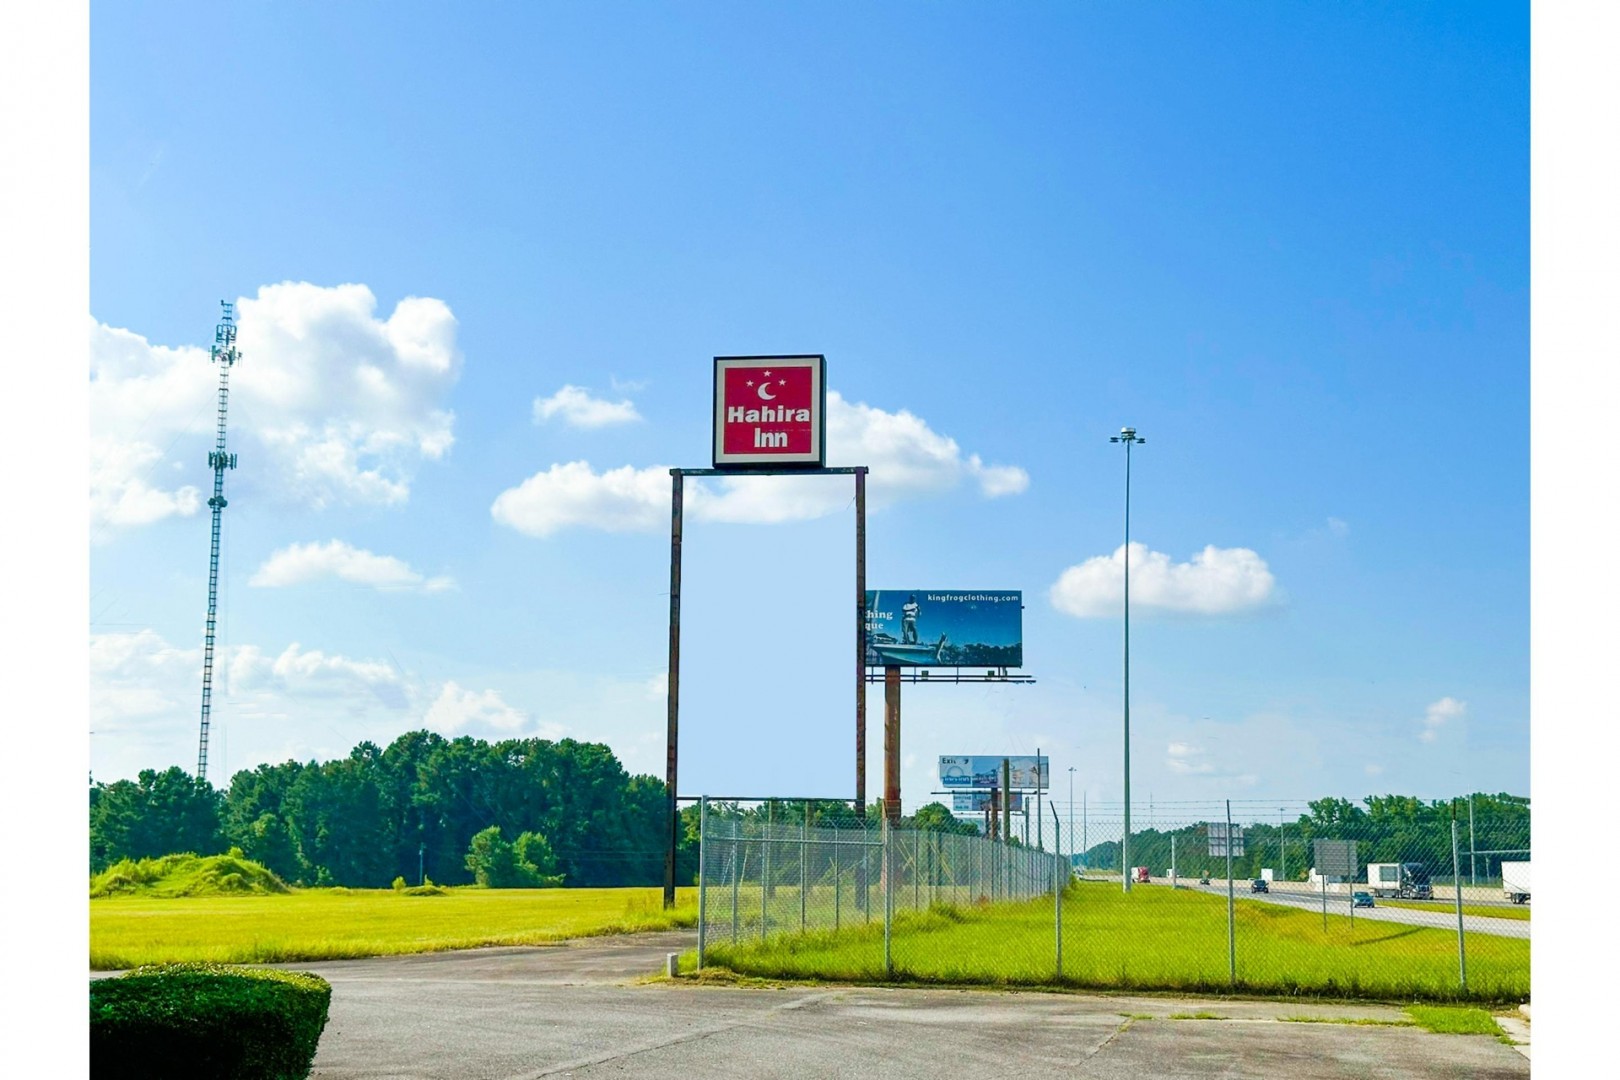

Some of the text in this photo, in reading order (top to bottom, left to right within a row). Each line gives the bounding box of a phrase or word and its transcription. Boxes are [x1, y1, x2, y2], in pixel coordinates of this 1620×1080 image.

[727, 405, 811, 423] Hahira
[753, 427, 788, 448] Inn
[927, 593, 1019, 603] kingfrogclothing.com
[865, 622, 884, 631] que
